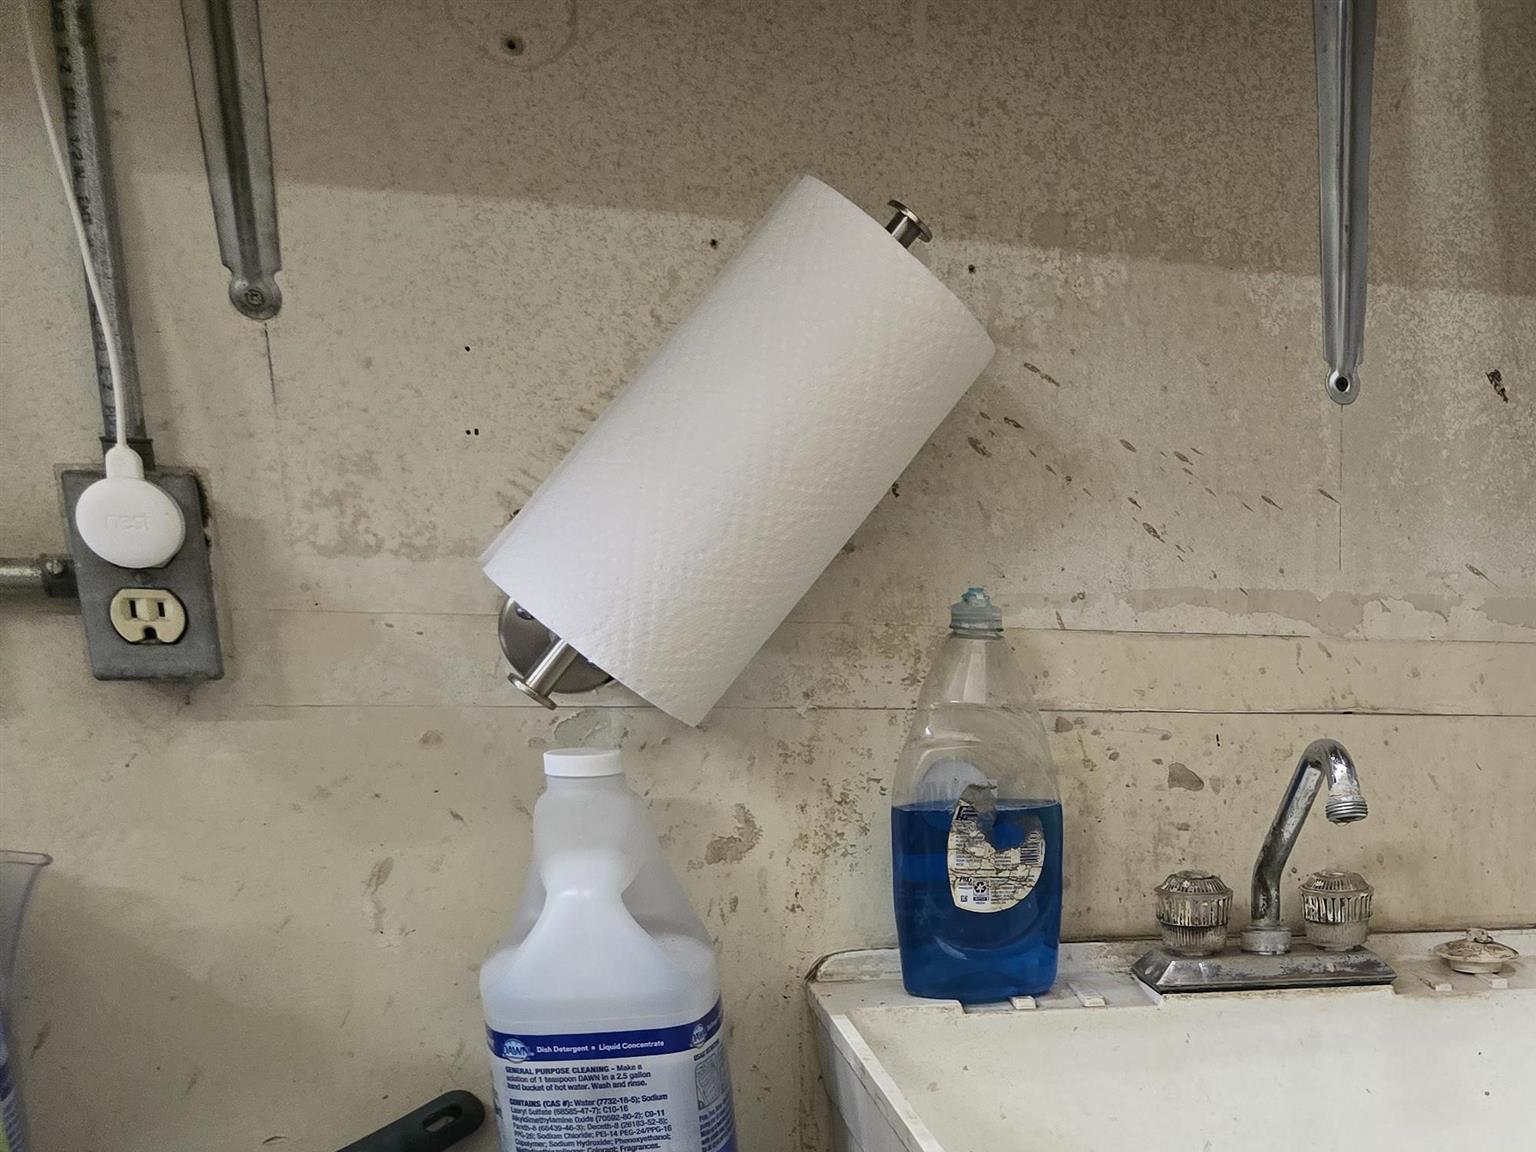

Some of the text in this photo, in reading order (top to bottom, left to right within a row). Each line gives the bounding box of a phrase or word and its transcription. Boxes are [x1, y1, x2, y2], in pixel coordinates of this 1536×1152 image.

[553, 1045, 589, 1053] Detergent
[599, 1043, 621, 1051] Liquid
[622, 1040, 664, 1050] Concentrate
[505, 1066, 534, 1075] GENERAL
[535, 1066, 570, 1075] PURPOSE
[571, 1065, 609, 1075] CLEANING
[544, 1076, 577, 1084] teaspoon
[578, 1074, 600, 1082] DAWN
[616, 1072, 628, 1080] 2.5
[629, 1071, 651, 1080] gallon
[555, 1083, 567, 1091] hot
[591, 1082, 612, 1090] Wash
[543, 1100, 561, 1108] (CAS
[574, 1099, 595, 1107] Water
[641, 1093, 668, 1102] Sodium
